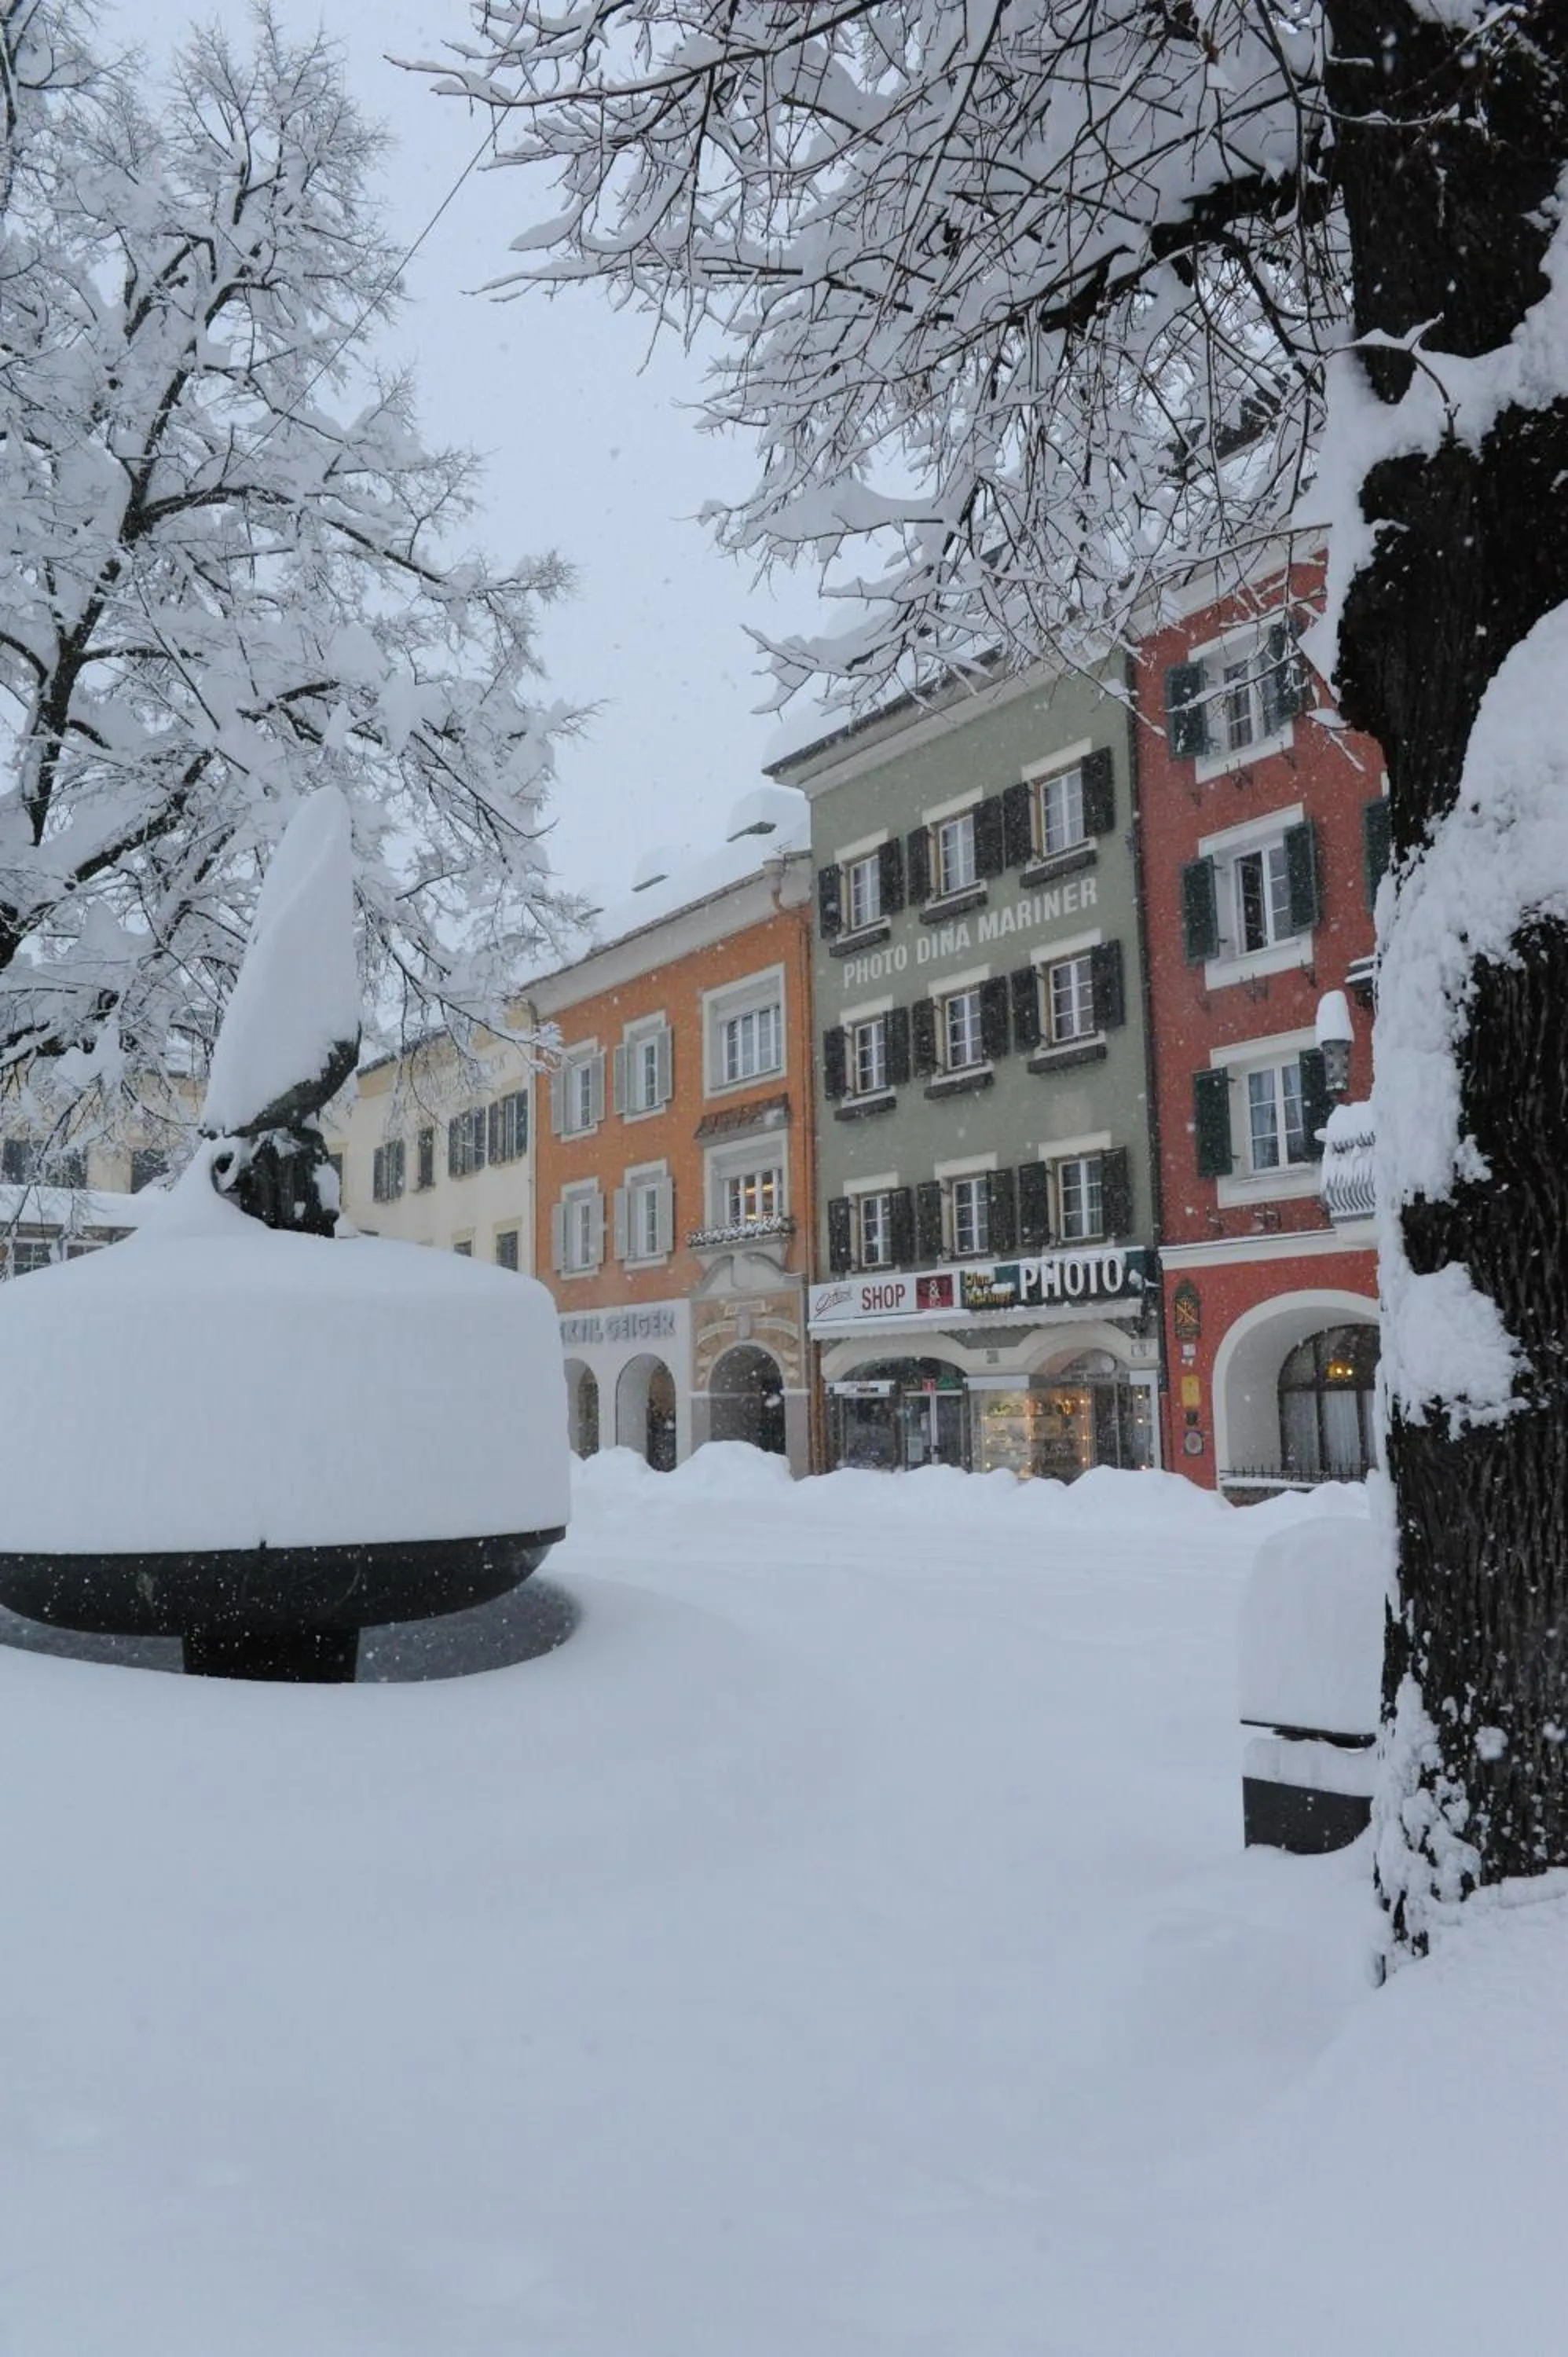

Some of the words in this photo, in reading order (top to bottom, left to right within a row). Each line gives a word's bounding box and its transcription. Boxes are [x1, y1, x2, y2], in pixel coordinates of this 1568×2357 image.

[843, 944, 908, 988] PHOTO
[917, 923, 971, 964] DINA
[979, 877, 1097, 944] MARINER
[862, 1284, 906, 1310] SHOP
[1020, 1256, 1123, 1300] PHOTO
